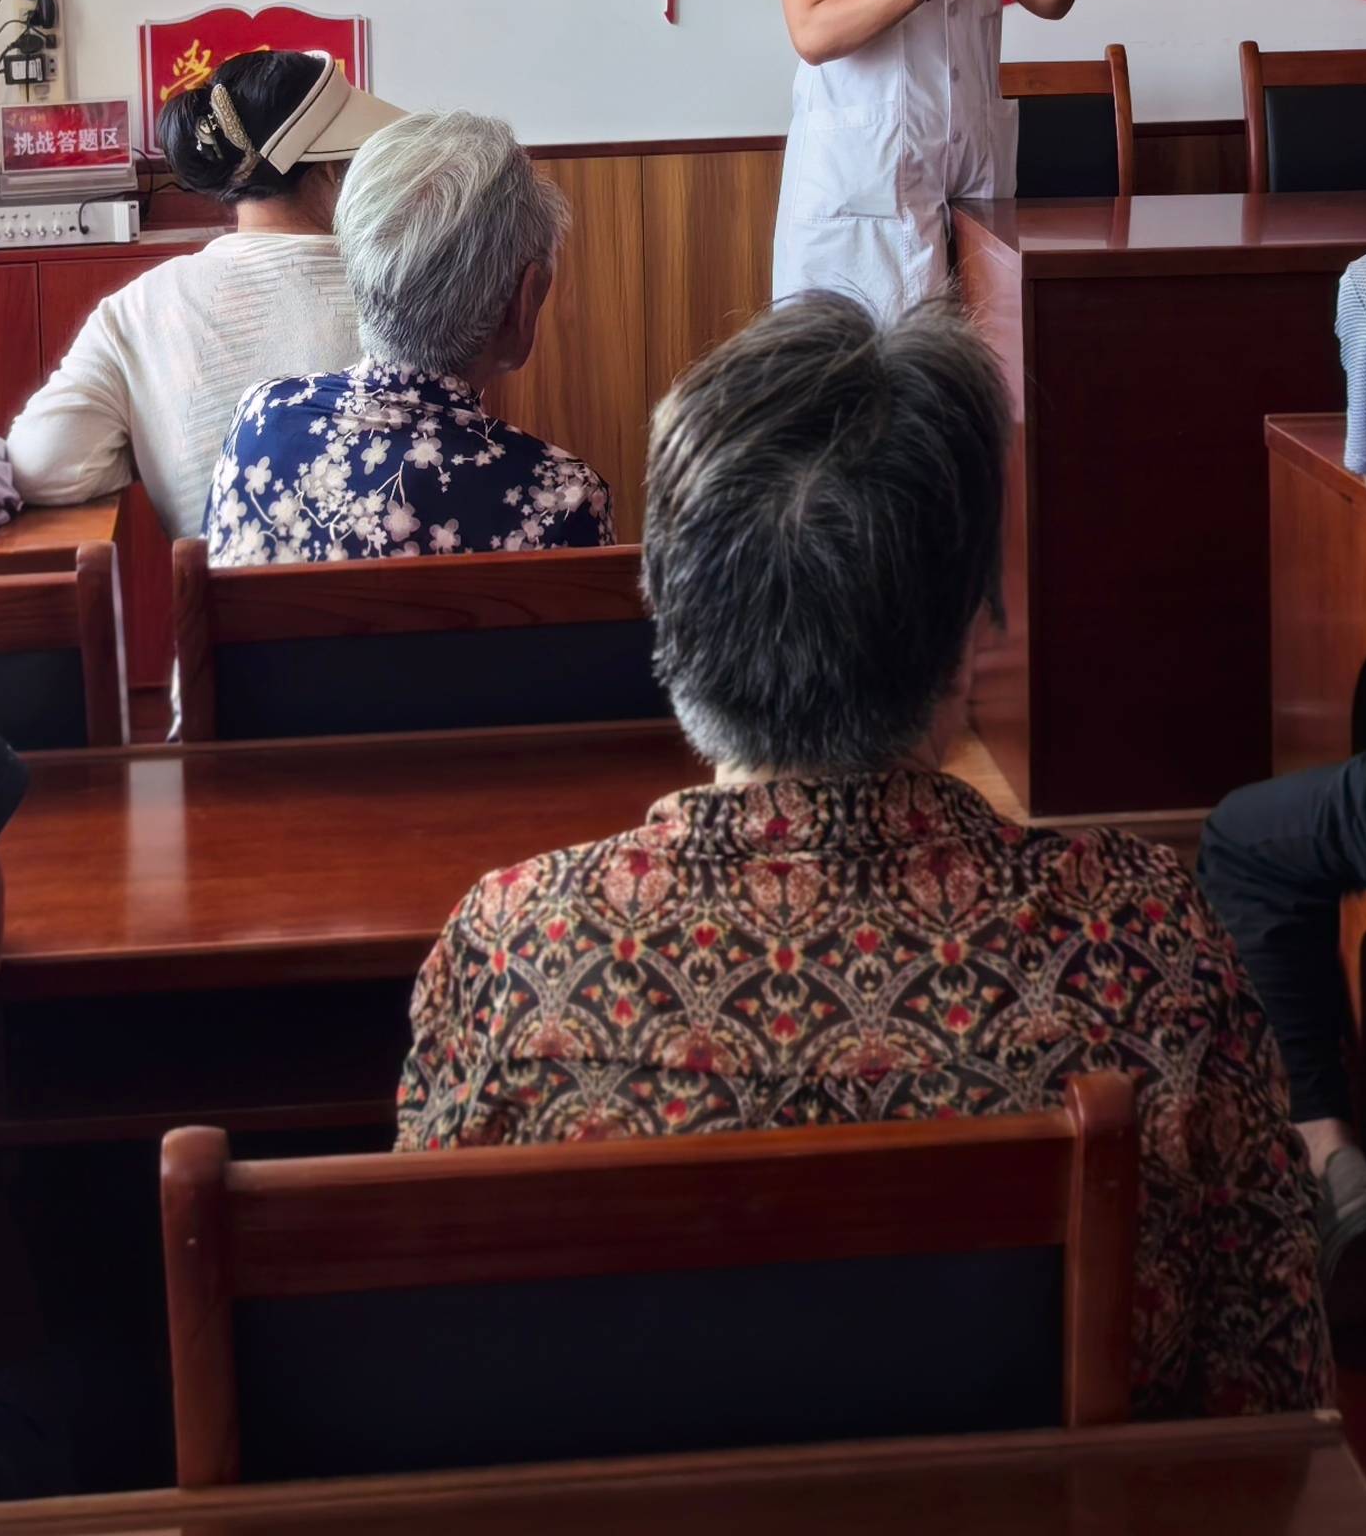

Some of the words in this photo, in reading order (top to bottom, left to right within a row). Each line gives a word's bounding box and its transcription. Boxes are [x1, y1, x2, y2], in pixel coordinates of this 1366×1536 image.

[13, 127, 121, 156] 挑战答题区
